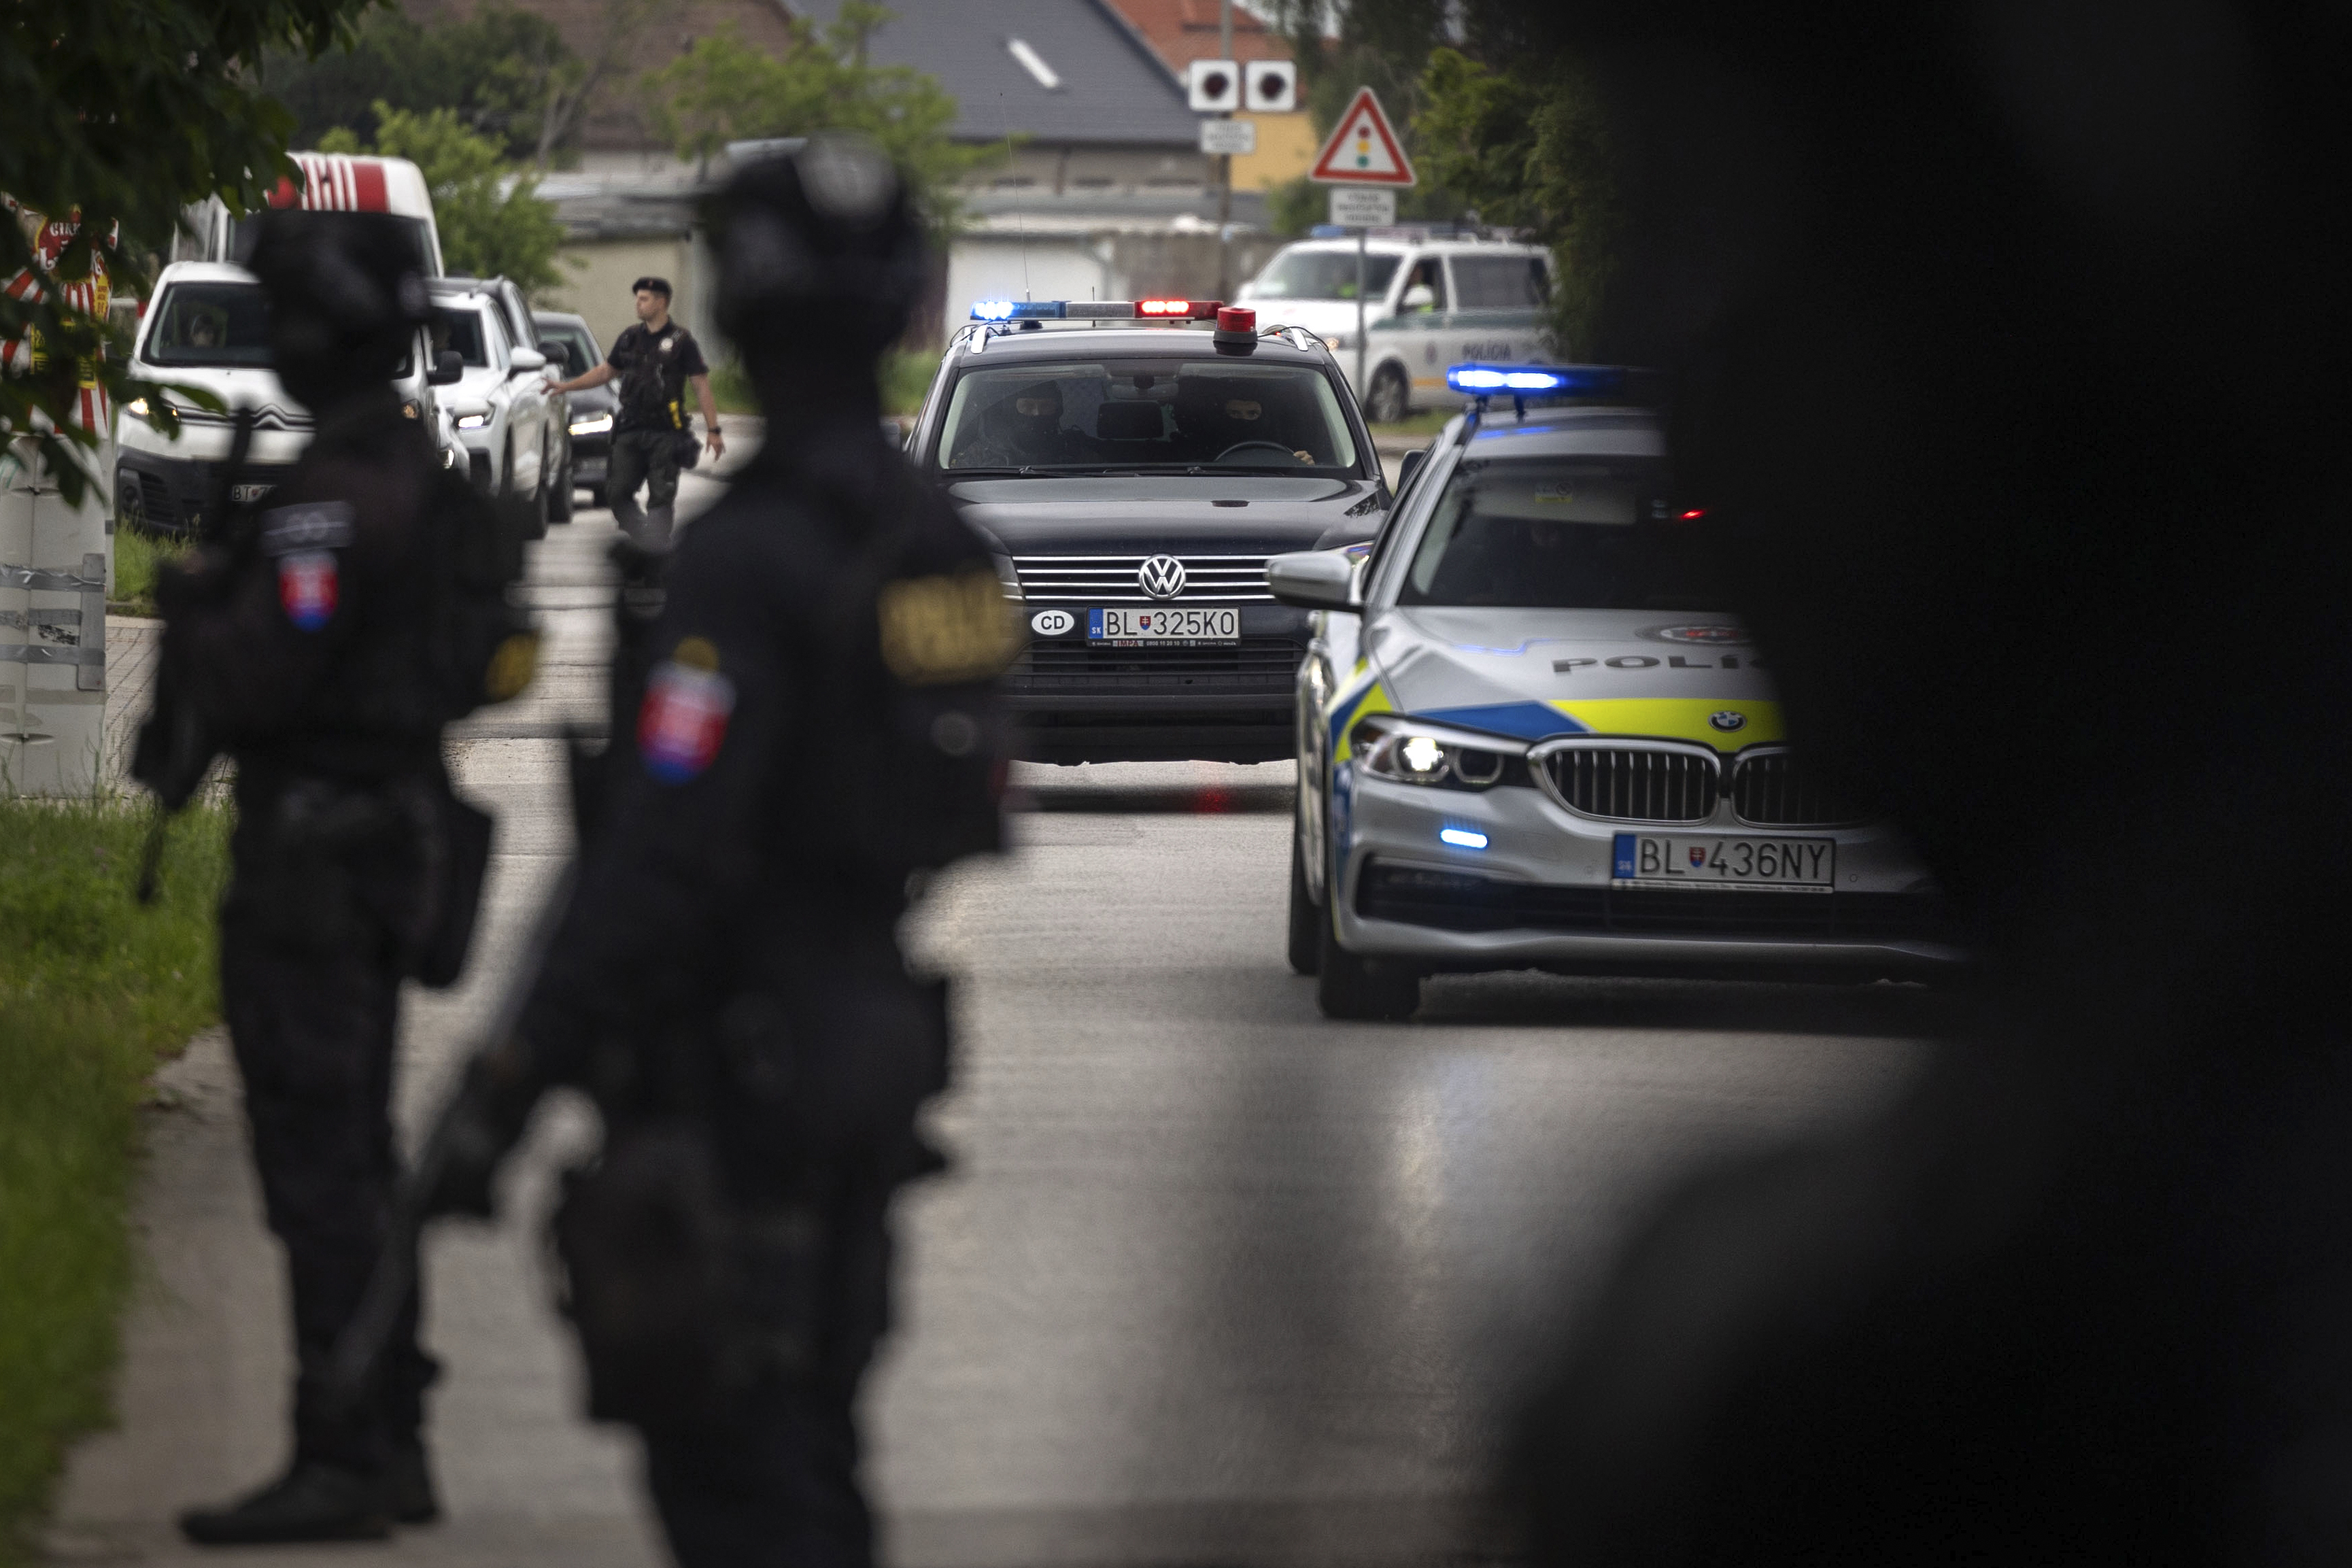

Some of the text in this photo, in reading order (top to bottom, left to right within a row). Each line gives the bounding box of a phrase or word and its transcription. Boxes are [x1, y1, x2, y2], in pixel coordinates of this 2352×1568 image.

[49, 222, 81, 237] CIRK
[233, 485, 251, 500] BT
[1040, 615, 1065, 630] CD
[1106, 611, 1138, 636] BL
[1641, 838, 1826, 879] BL 436NY
